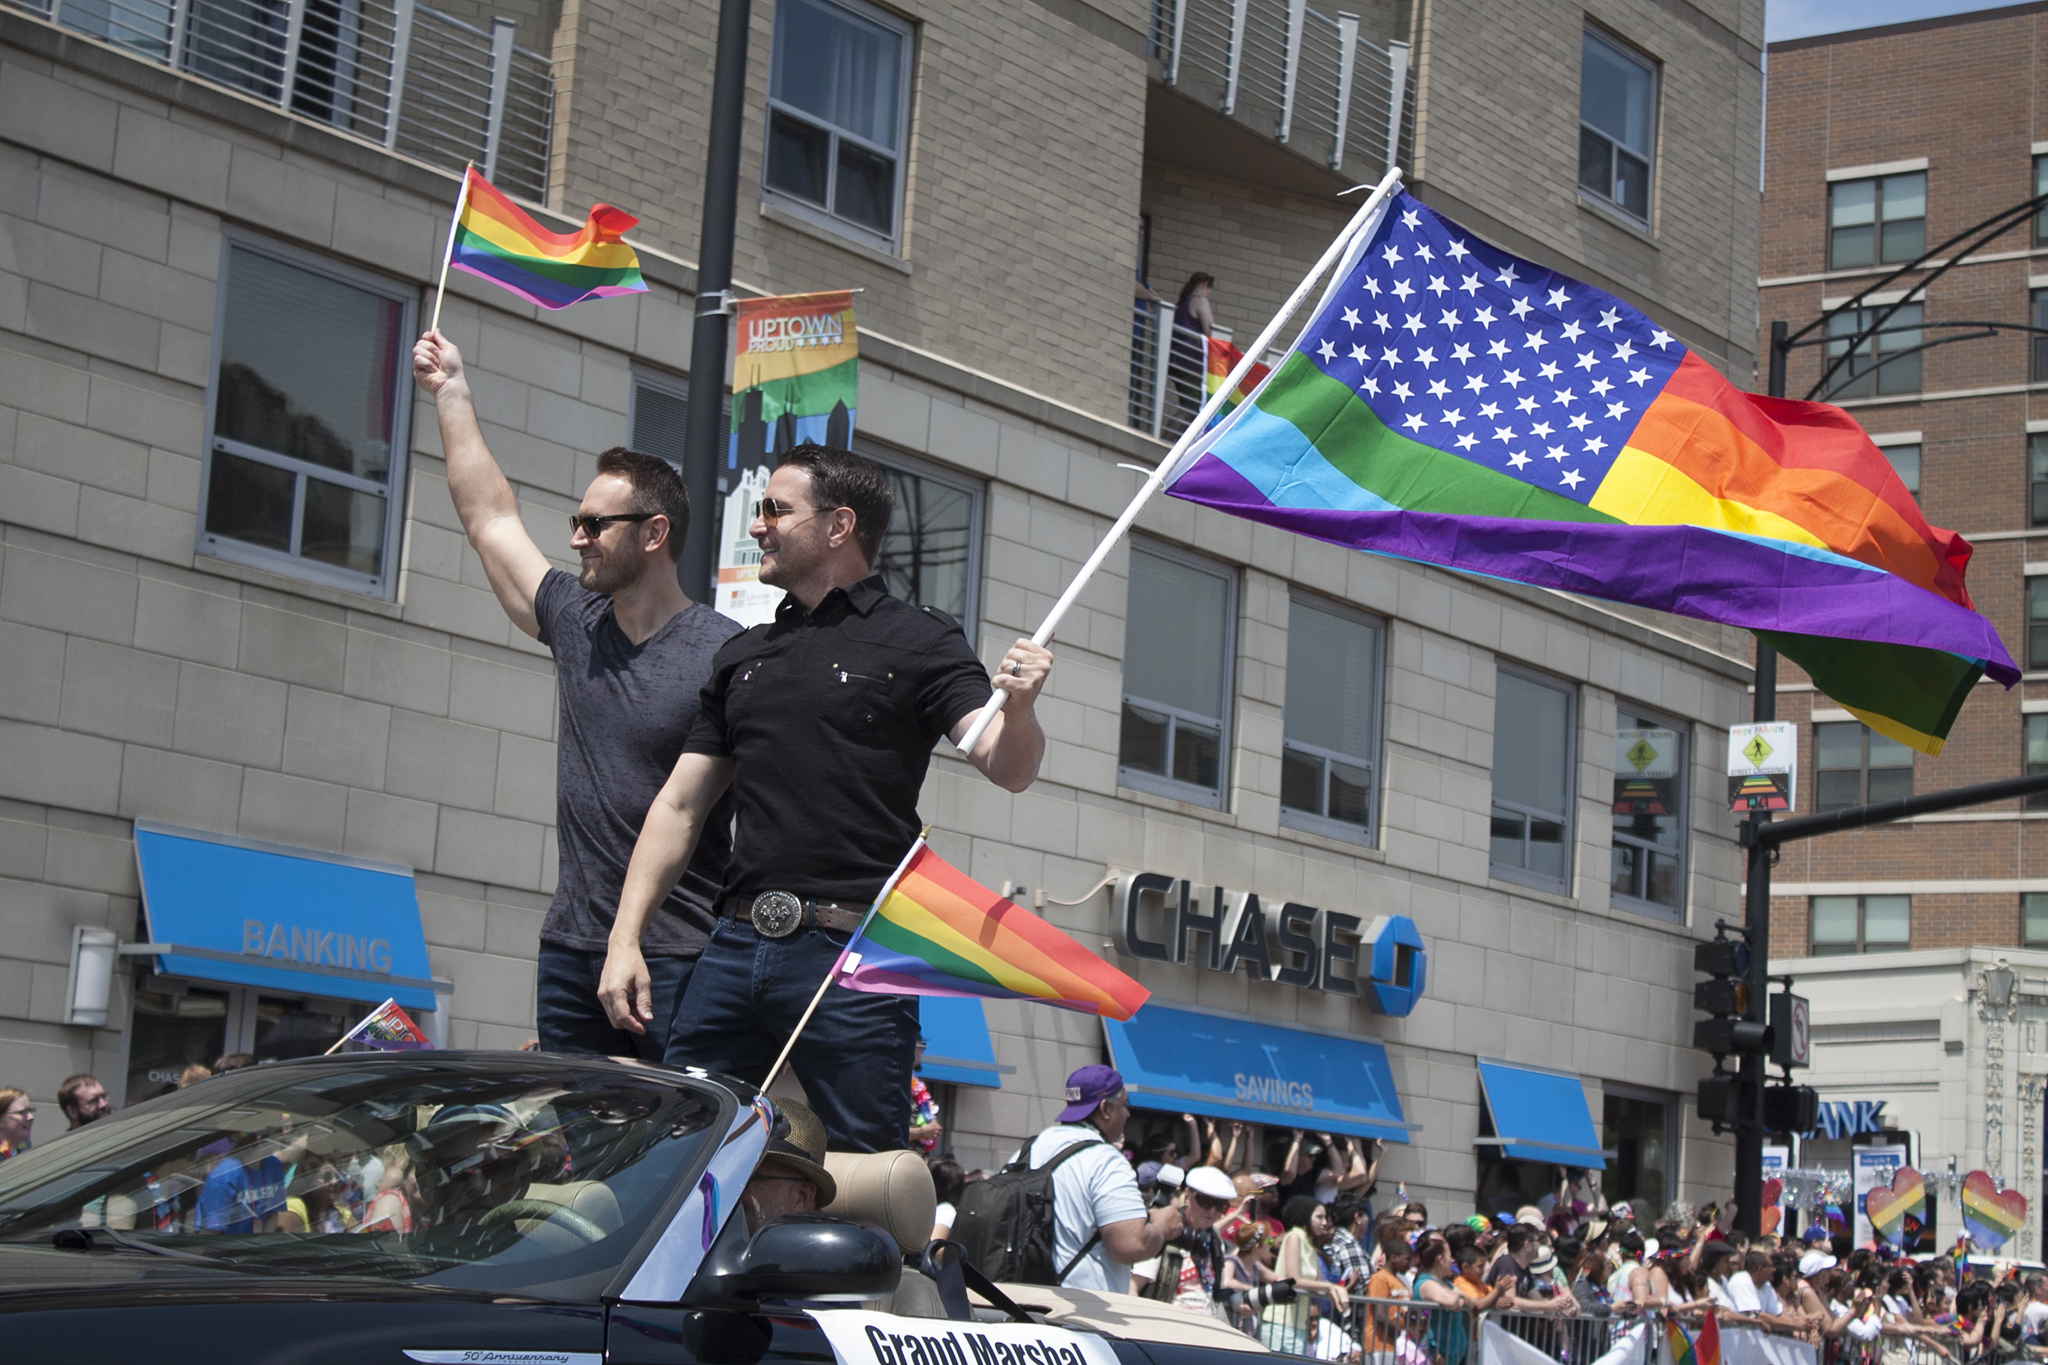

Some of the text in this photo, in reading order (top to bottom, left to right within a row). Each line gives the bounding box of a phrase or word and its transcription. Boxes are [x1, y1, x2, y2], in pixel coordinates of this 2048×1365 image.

[748, 313, 843, 339] UPTOWN
[748, 339, 795, 354] PROUD
[736, 568, 759, 580] UPTO
[1732, 725, 1785, 736] PRIDE PARADE
[1731, 765, 1787, 776] STREET CROSSING
[1113, 872, 1362, 998] CHASE
[243, 918, 392, 975] BANKING
[380, 1009, 417, 1042] UPTO
[148, 1070, 180, 1085] CHAS
[1234, 1073, 1313, 1110] SAVINGS
[1801, 1101, 1887, 1140] ANK
[482, 1352, 569, 1364] Anniversary
